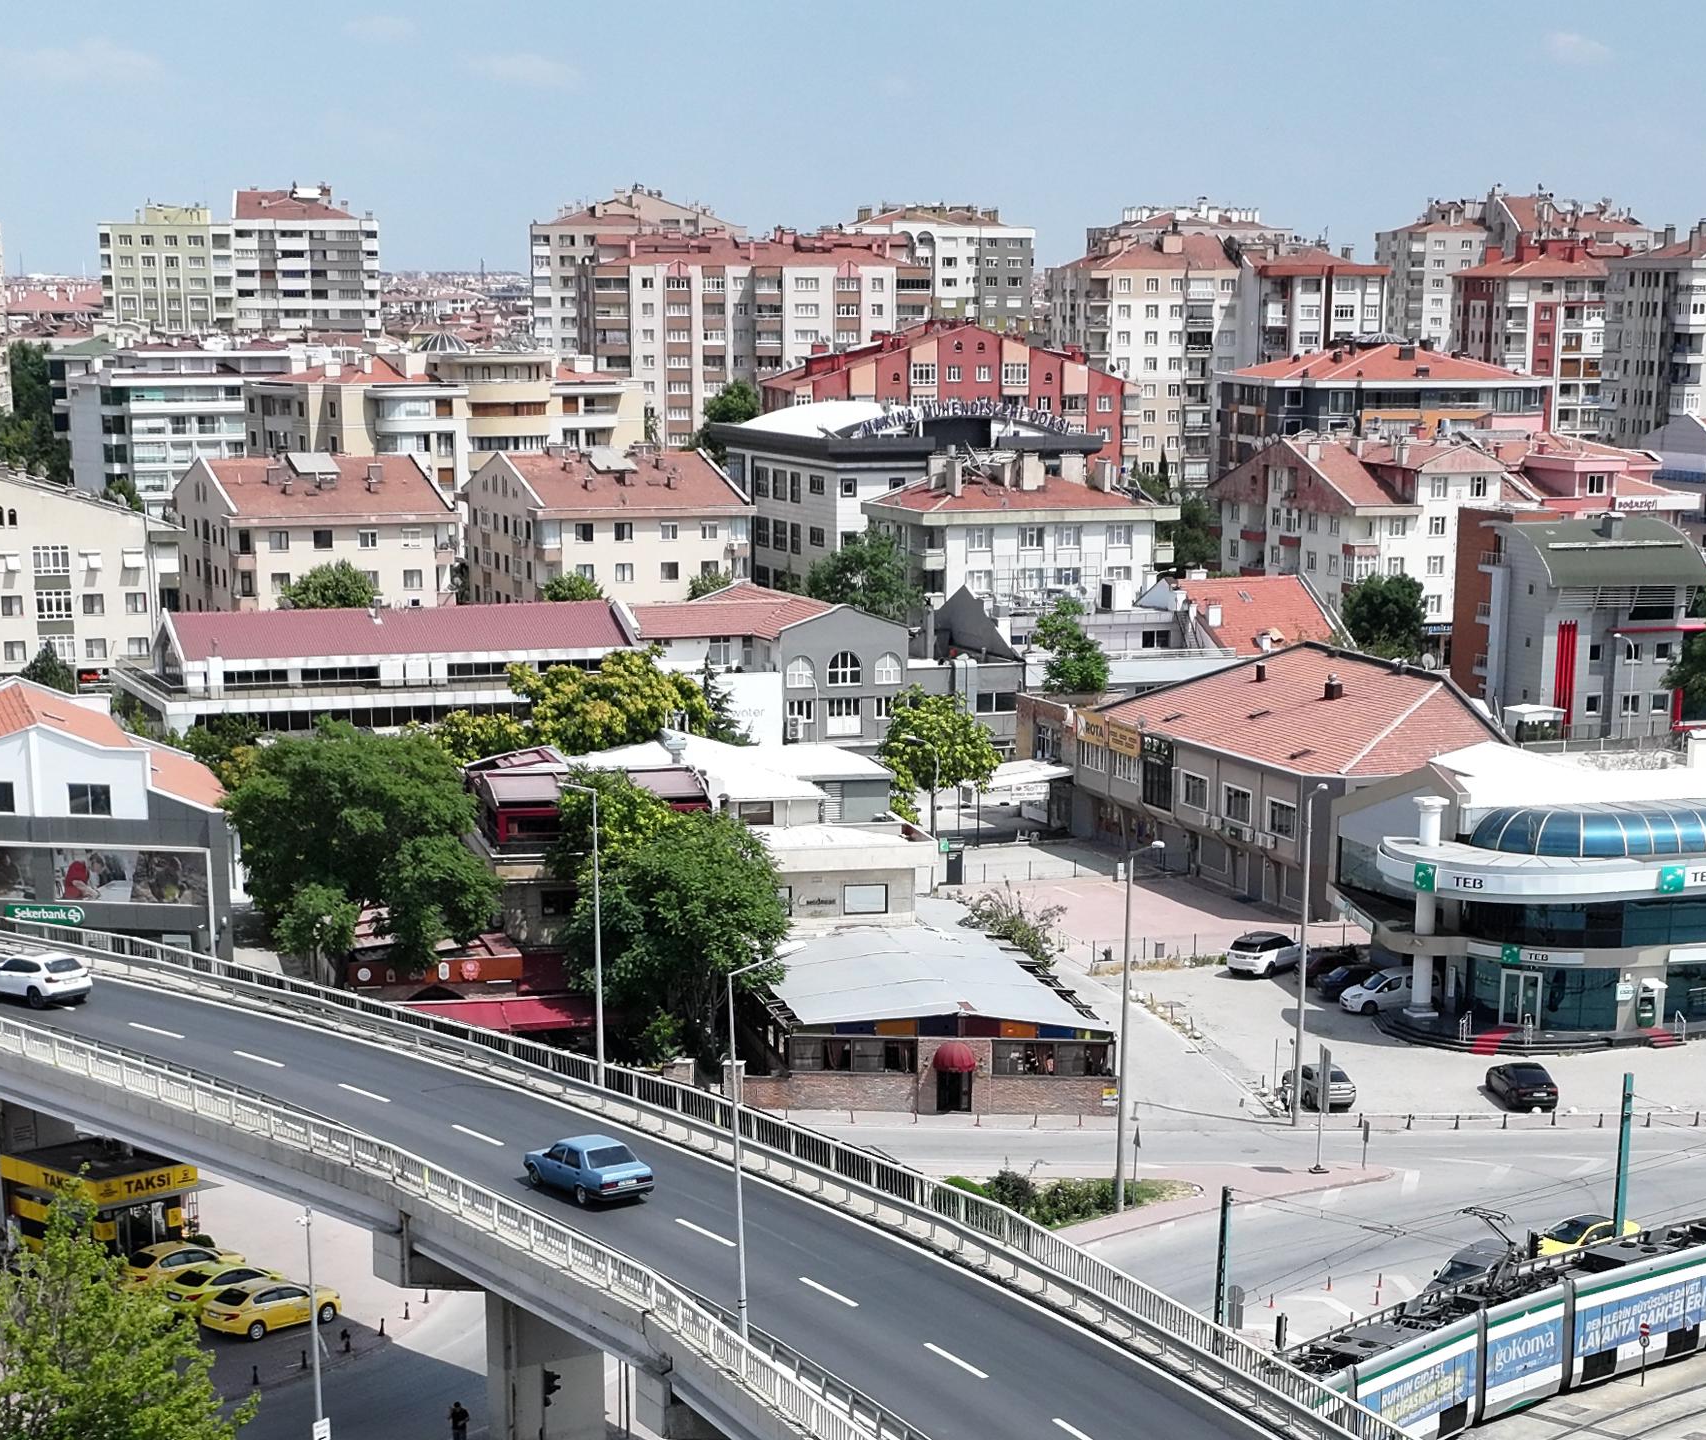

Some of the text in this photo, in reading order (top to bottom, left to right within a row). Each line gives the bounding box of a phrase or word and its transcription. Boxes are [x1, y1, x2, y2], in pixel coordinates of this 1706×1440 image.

[1085, 722, 1104, 738] ROTA
[1453, 876, 1484, 889] TEB
[1527, 952, 1549, 962] TEB
[1674, 1281, 1701, 1300] DAVET
[1578, 1316, 1636, 1353] LAVANTA
[1494, 1331, 1556, 1372] goKonya
[1381, 1376, 1414, 1406] RUHUN
